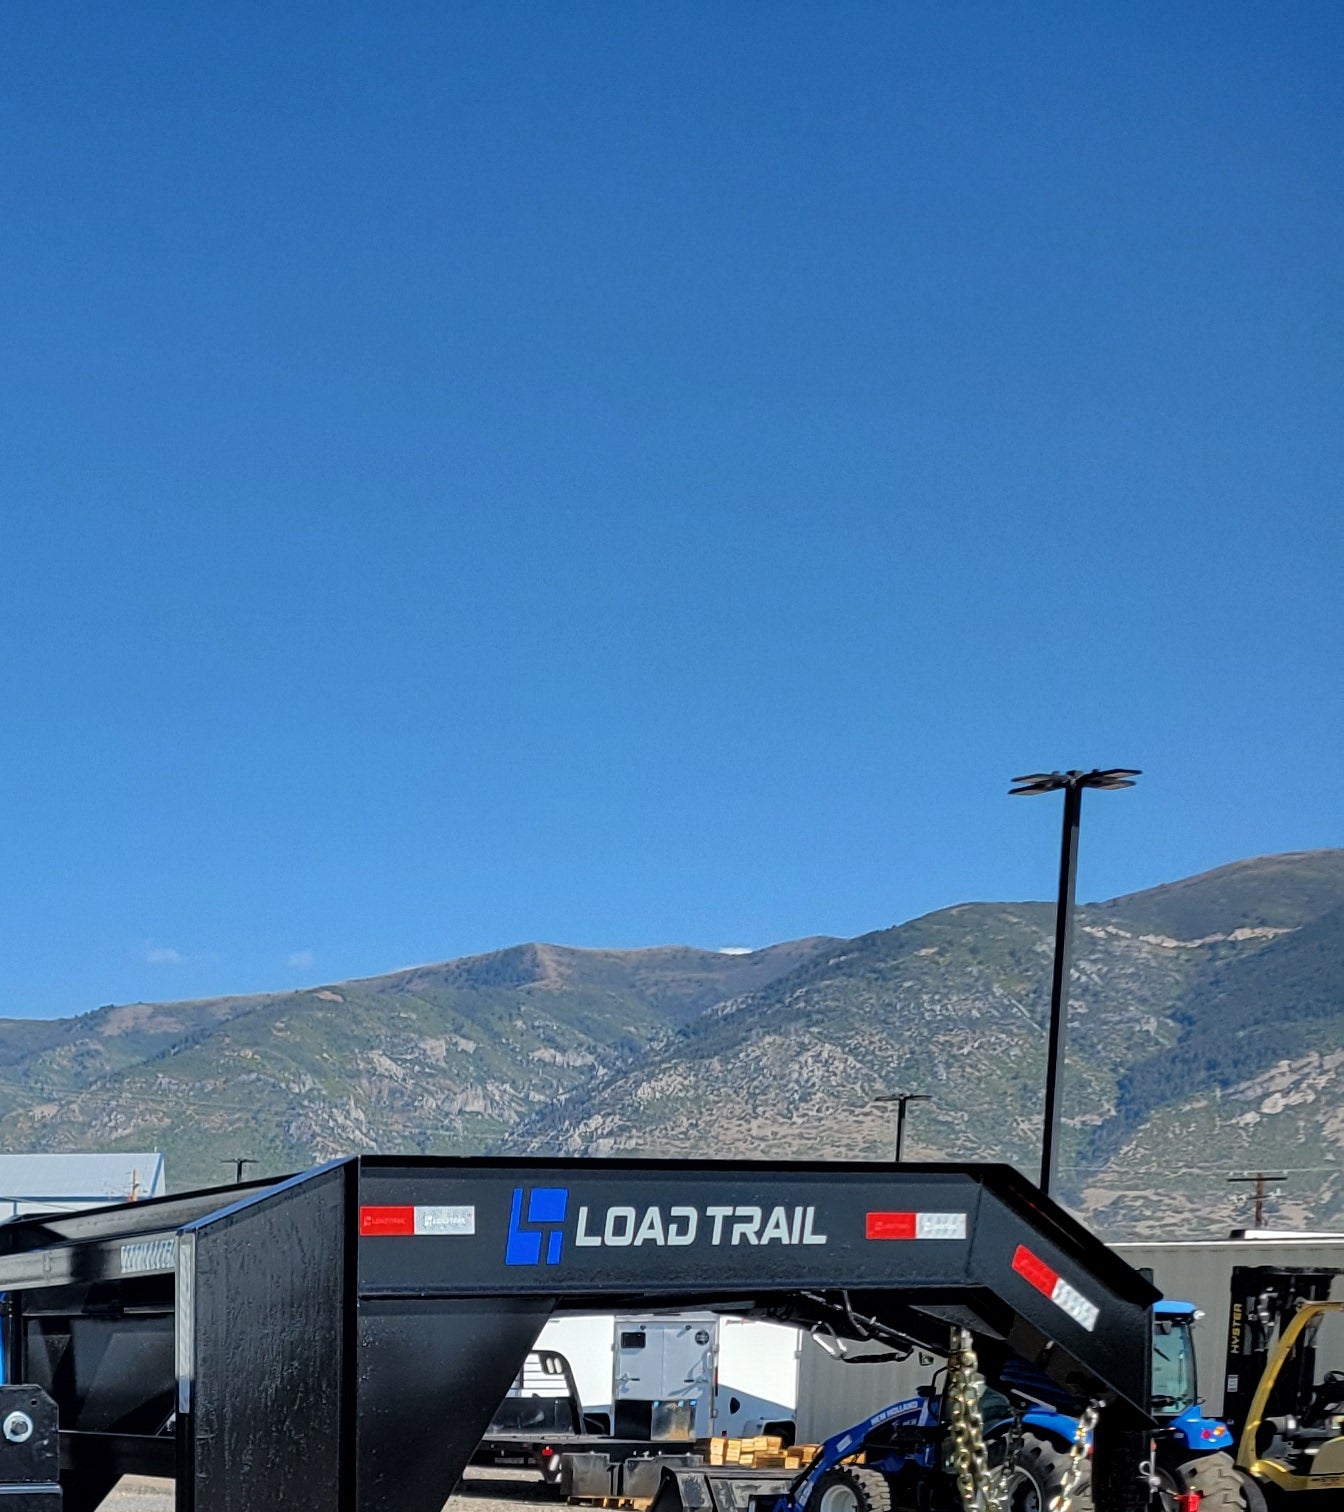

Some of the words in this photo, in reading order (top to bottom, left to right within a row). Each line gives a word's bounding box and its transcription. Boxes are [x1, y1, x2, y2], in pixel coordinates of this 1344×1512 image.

[575, 1206, 698, 1247] LOAD
[705, 1206, 828, 1246] TRAIL
[1230, 1303, 1243, 1354] HYSTER
